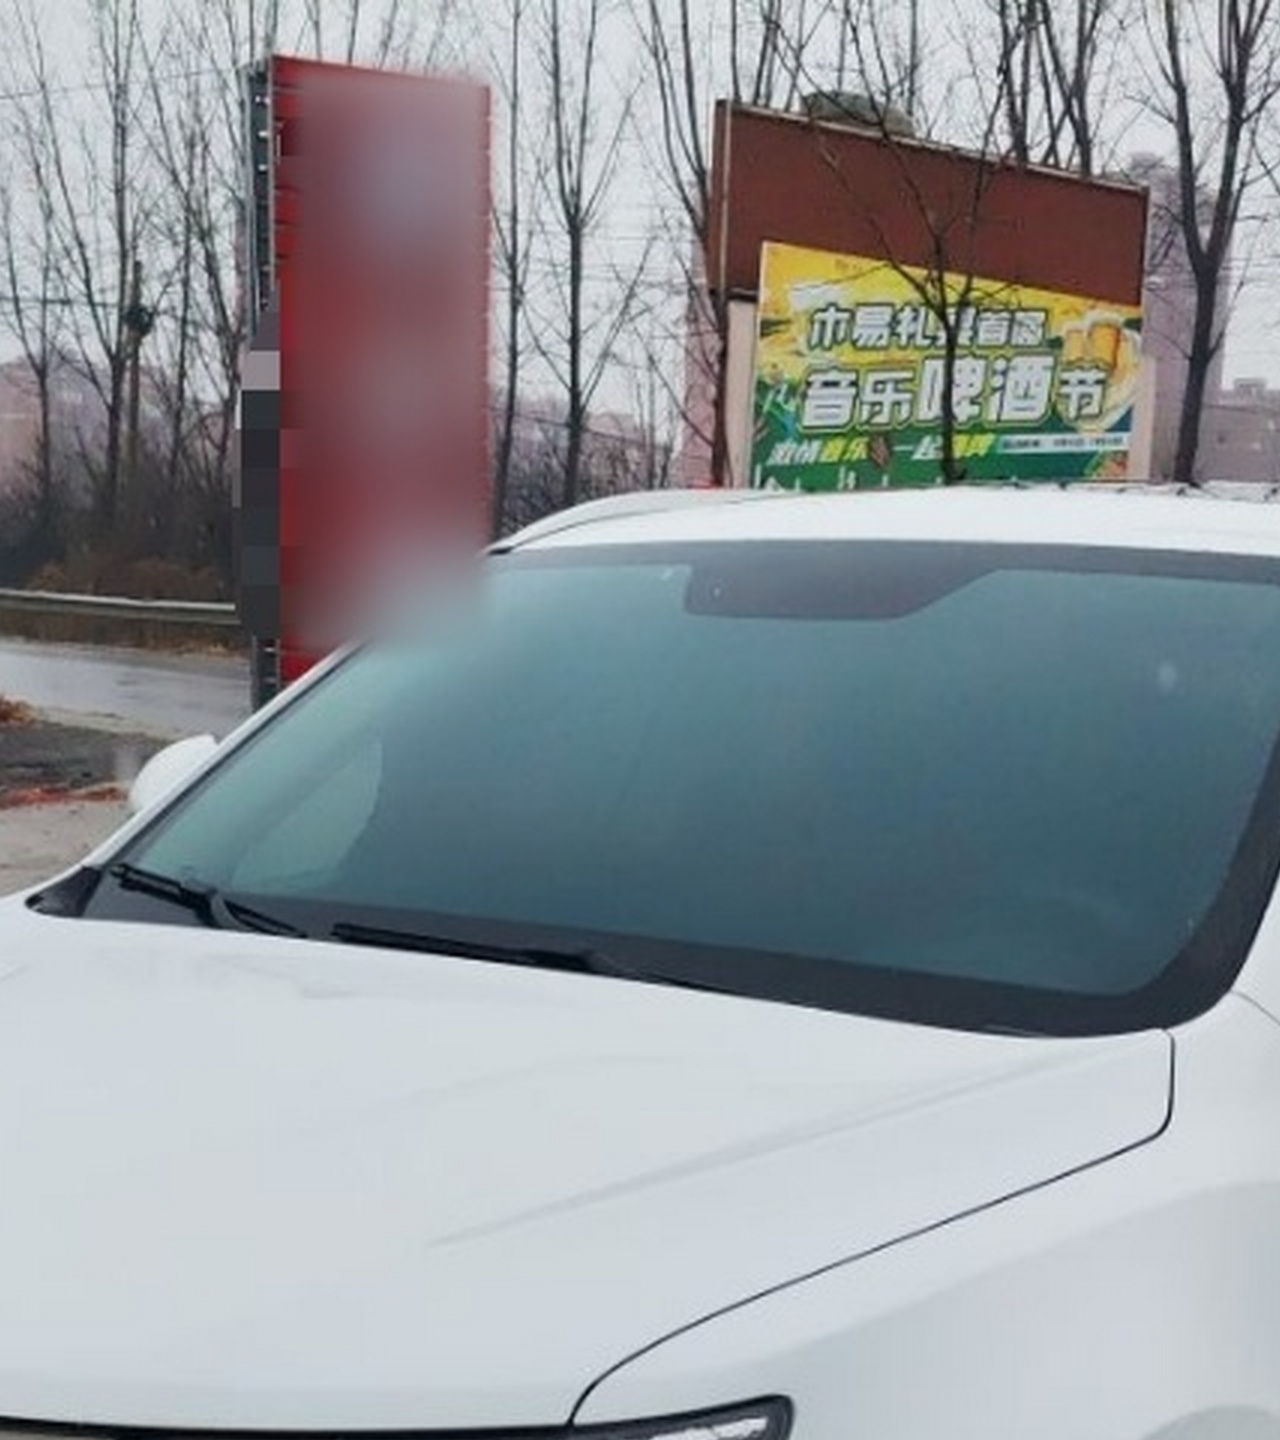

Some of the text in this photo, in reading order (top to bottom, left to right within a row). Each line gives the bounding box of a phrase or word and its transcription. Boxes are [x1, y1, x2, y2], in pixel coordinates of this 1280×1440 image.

[803, 356, 1107, 428] 音乐啤酒节
